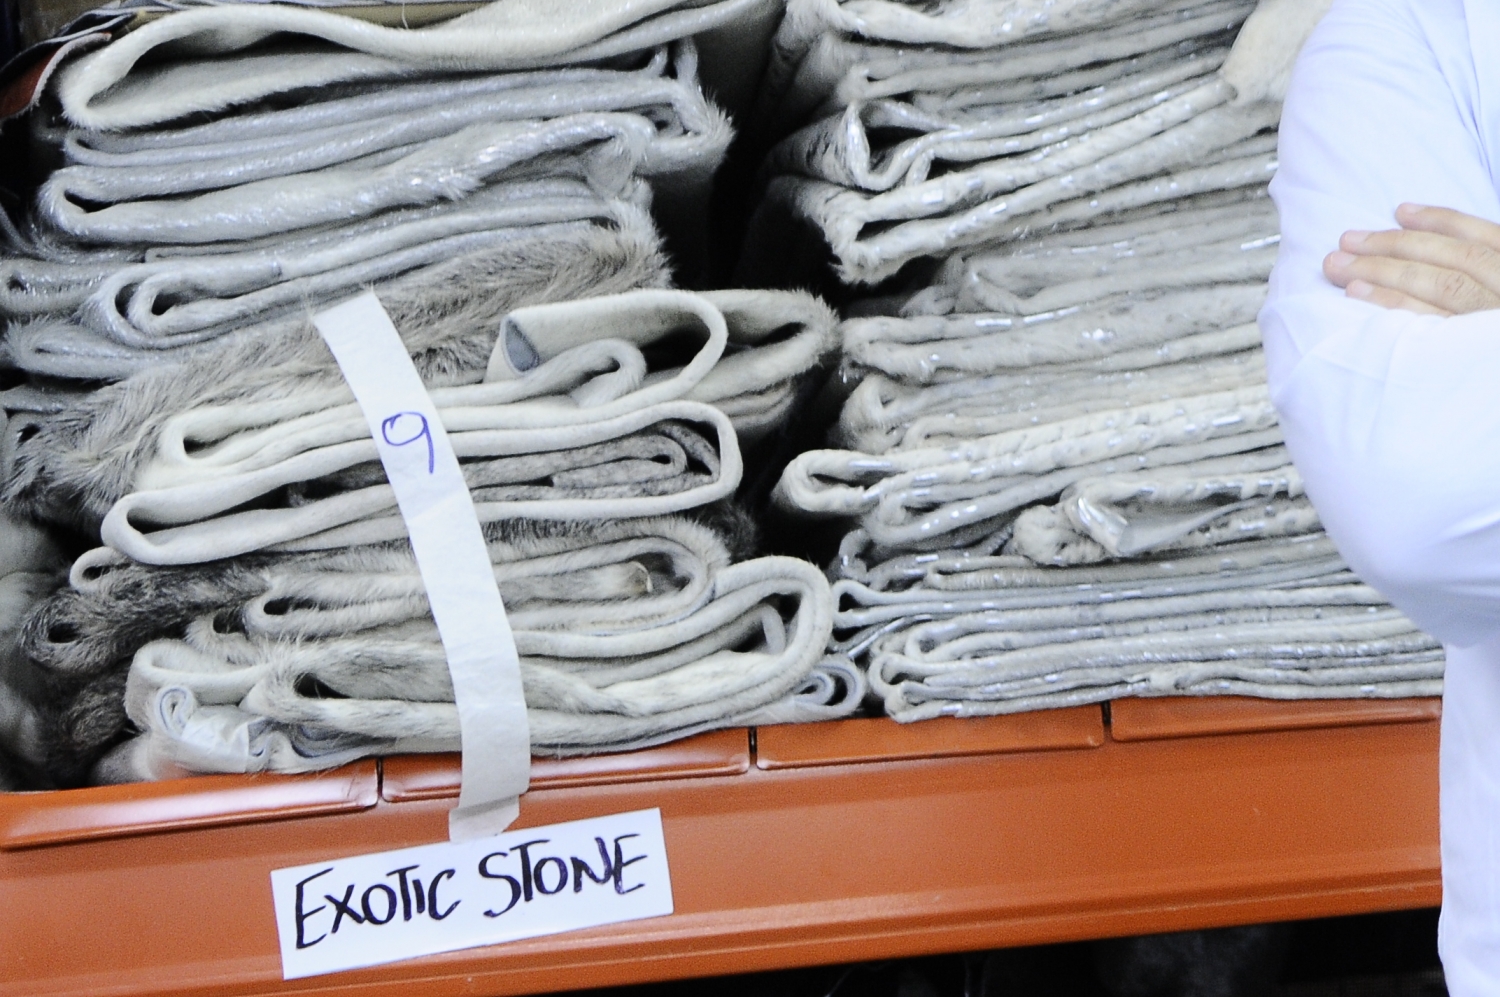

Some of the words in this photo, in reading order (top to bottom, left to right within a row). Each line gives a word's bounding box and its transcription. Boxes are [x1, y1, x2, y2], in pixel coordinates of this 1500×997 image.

[382, 411, 434, 475] 9
[295, 867, 462, 950] EXOTIC
[477, 833, 648, 918] STONE
